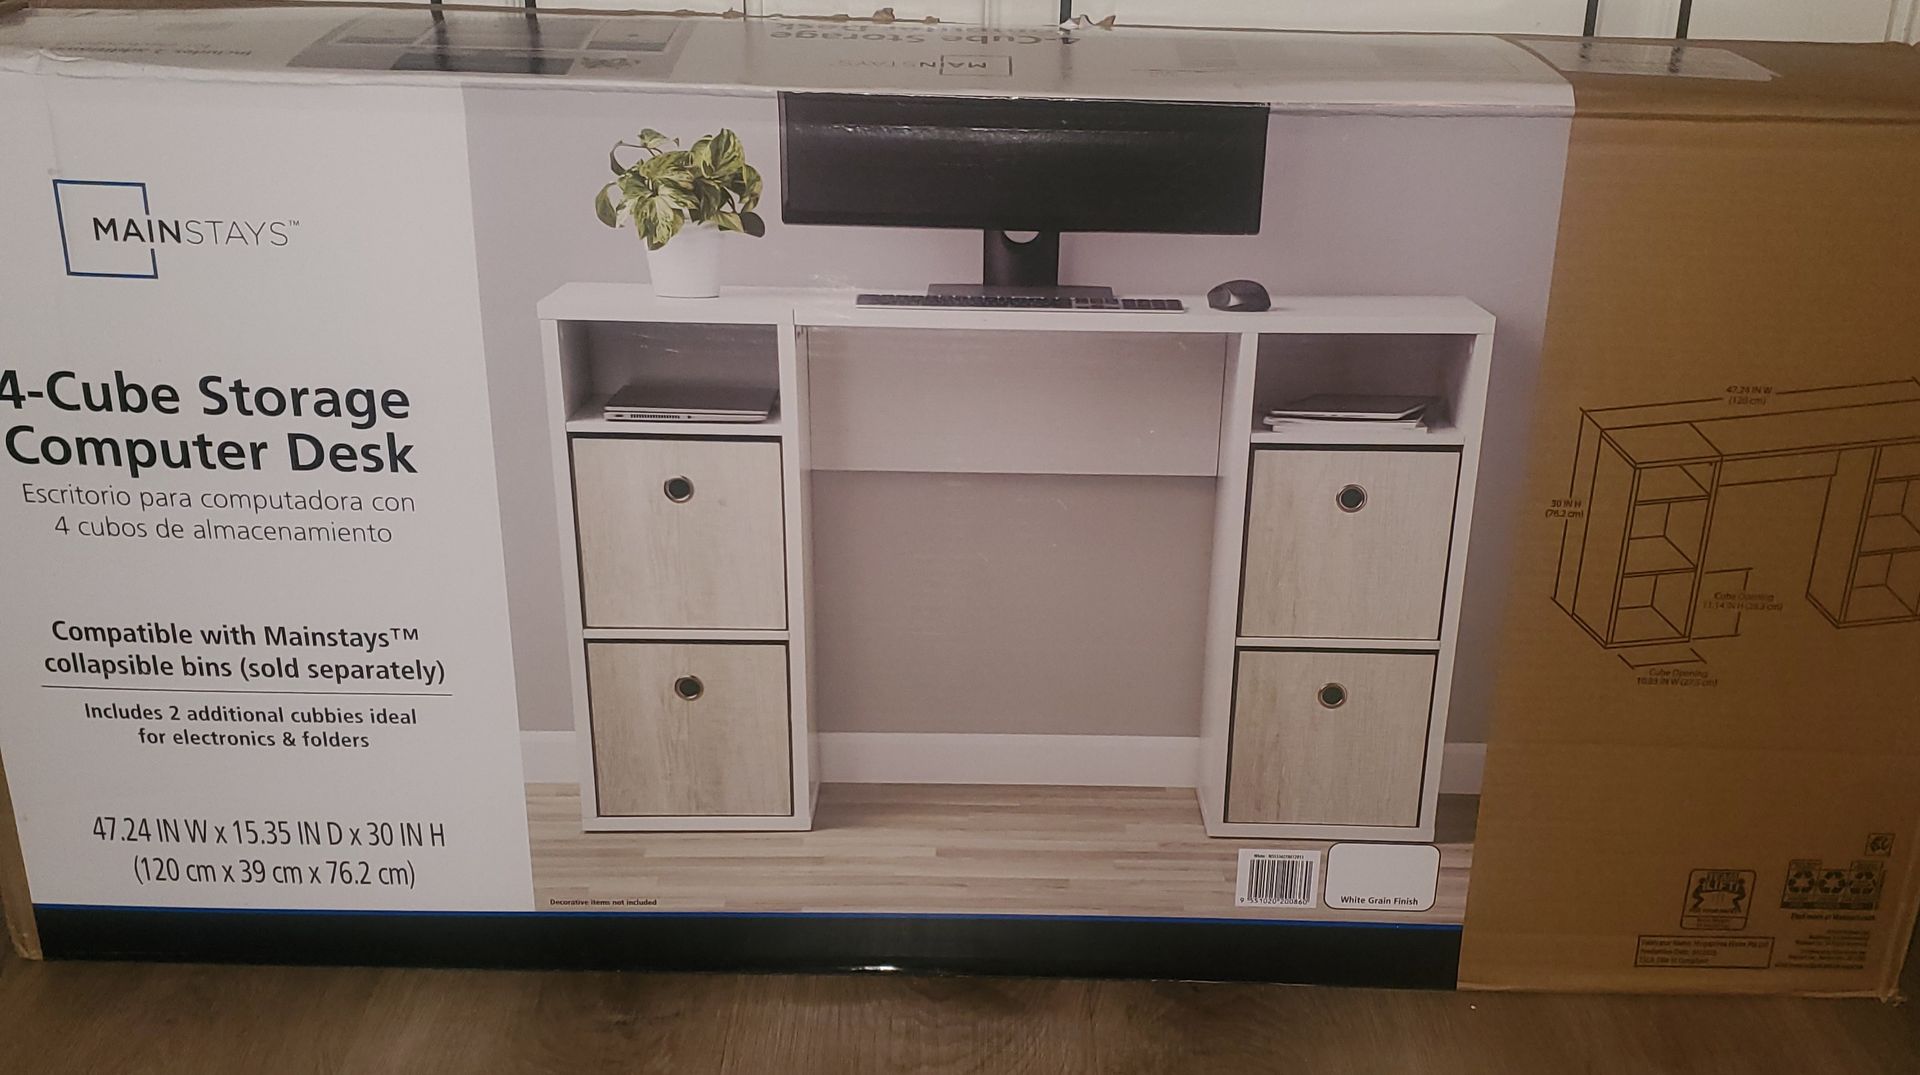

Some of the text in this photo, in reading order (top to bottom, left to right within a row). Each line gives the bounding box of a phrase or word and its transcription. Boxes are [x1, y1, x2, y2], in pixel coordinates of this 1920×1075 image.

[769, 30, 926, 44] Storage
[0, 369, 410, 430] 4-Cube Storage
[5, 424, 418, 479] Computer Desk
[22, 483, 415, 515] Escritorio para computadora con
[54, 515, 392, 543] 4 cubos de almacenamiento
[51, 620, 193, 648] Compatible
[199, 623, 256, 646] with
[44, 651, 445, 686] collapsible bins (sold separately)
[84, 702, 417, 725] Includes 2 additional cubbies ideal
[137, 727, 370, 748] for electronics & folders
[92, 816, 445, 847] 47.24 IN W x 15.35 IN D x 30 IN H
[134, 854, 415, 890] (120 cm x 39 cm x 76.2 cm)
[549, 898, 589, 906] Decorative
[626, 898, 658, 906] included
[1340, 895, 1419, 906] White Grain Finish
